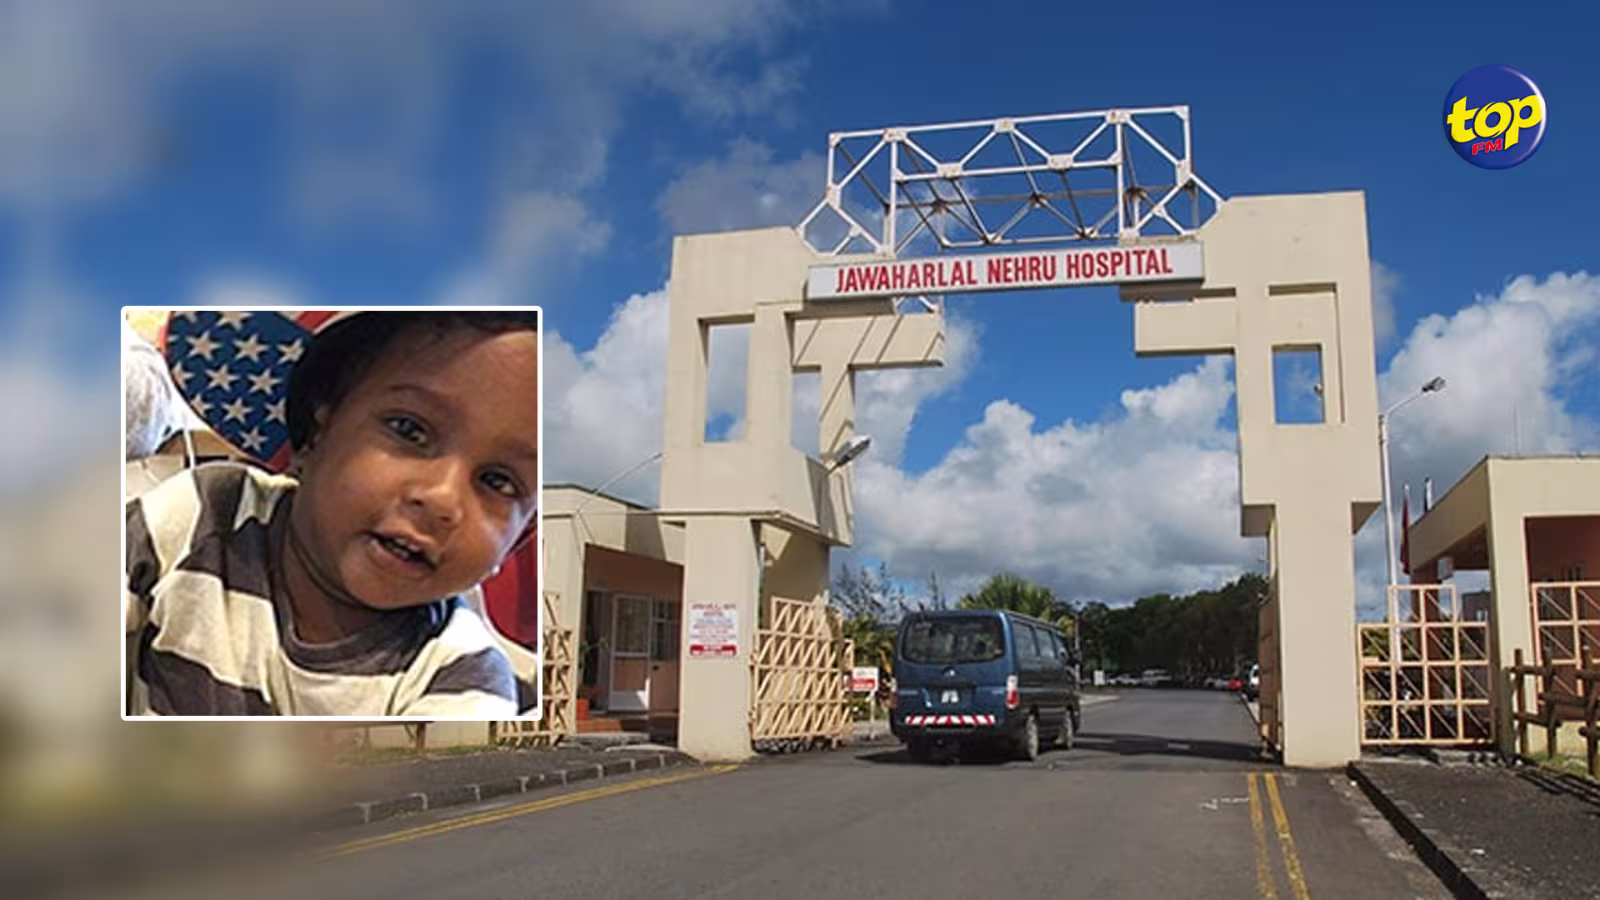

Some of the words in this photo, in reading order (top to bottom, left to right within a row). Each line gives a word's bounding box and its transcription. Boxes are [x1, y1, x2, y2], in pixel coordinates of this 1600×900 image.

[836, 260, 978, 293] JAWAHARLAL
[987, 253, 1057, 284] NEHRU
[1067, 248, 1173, 279] HOSPITAL
